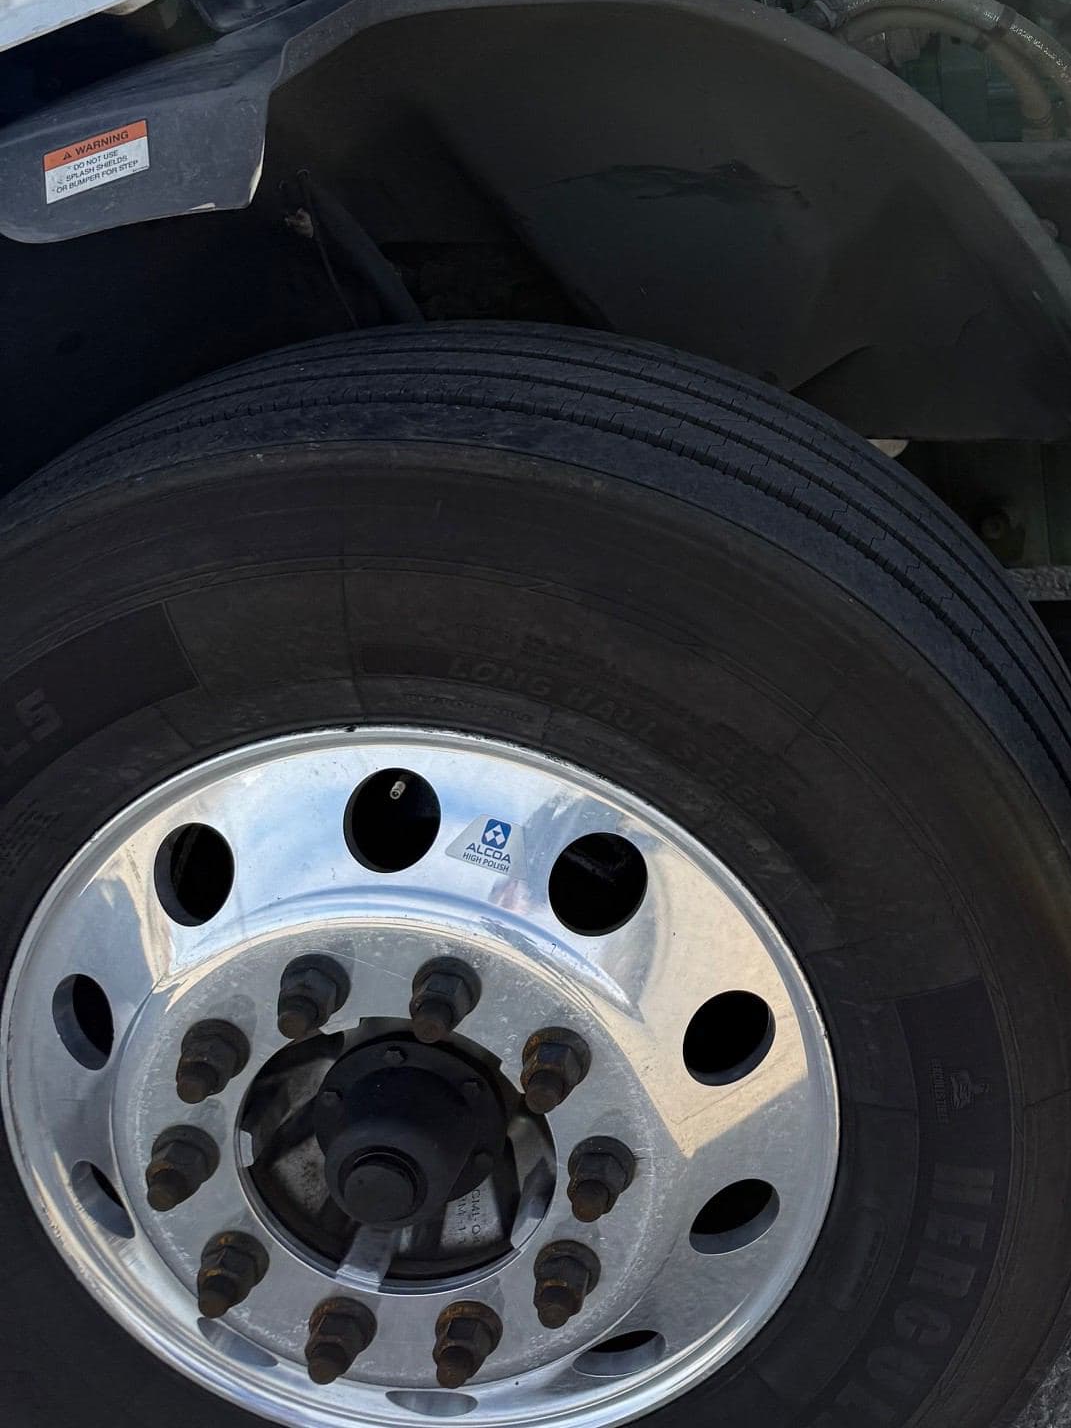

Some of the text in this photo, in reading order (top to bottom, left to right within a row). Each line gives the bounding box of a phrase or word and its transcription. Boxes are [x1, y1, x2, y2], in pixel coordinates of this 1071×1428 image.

[75, 130, 129, 155] WARNING
[66, 167, 95, 182] SPLASH
[96, 155, 128, 172] SHIELDS
[73, 150, 119, 170] DO NOT USE
[56, 184, 68, 194] OR
[69, 174, 101, 189] BUMPER
[102, 168, 118, 178] FOR
[119, 160, 139, 171] STEP
[463, 852, 510, 873] HIGH POLISH
[466, 842, 511, 864] ALCOA
